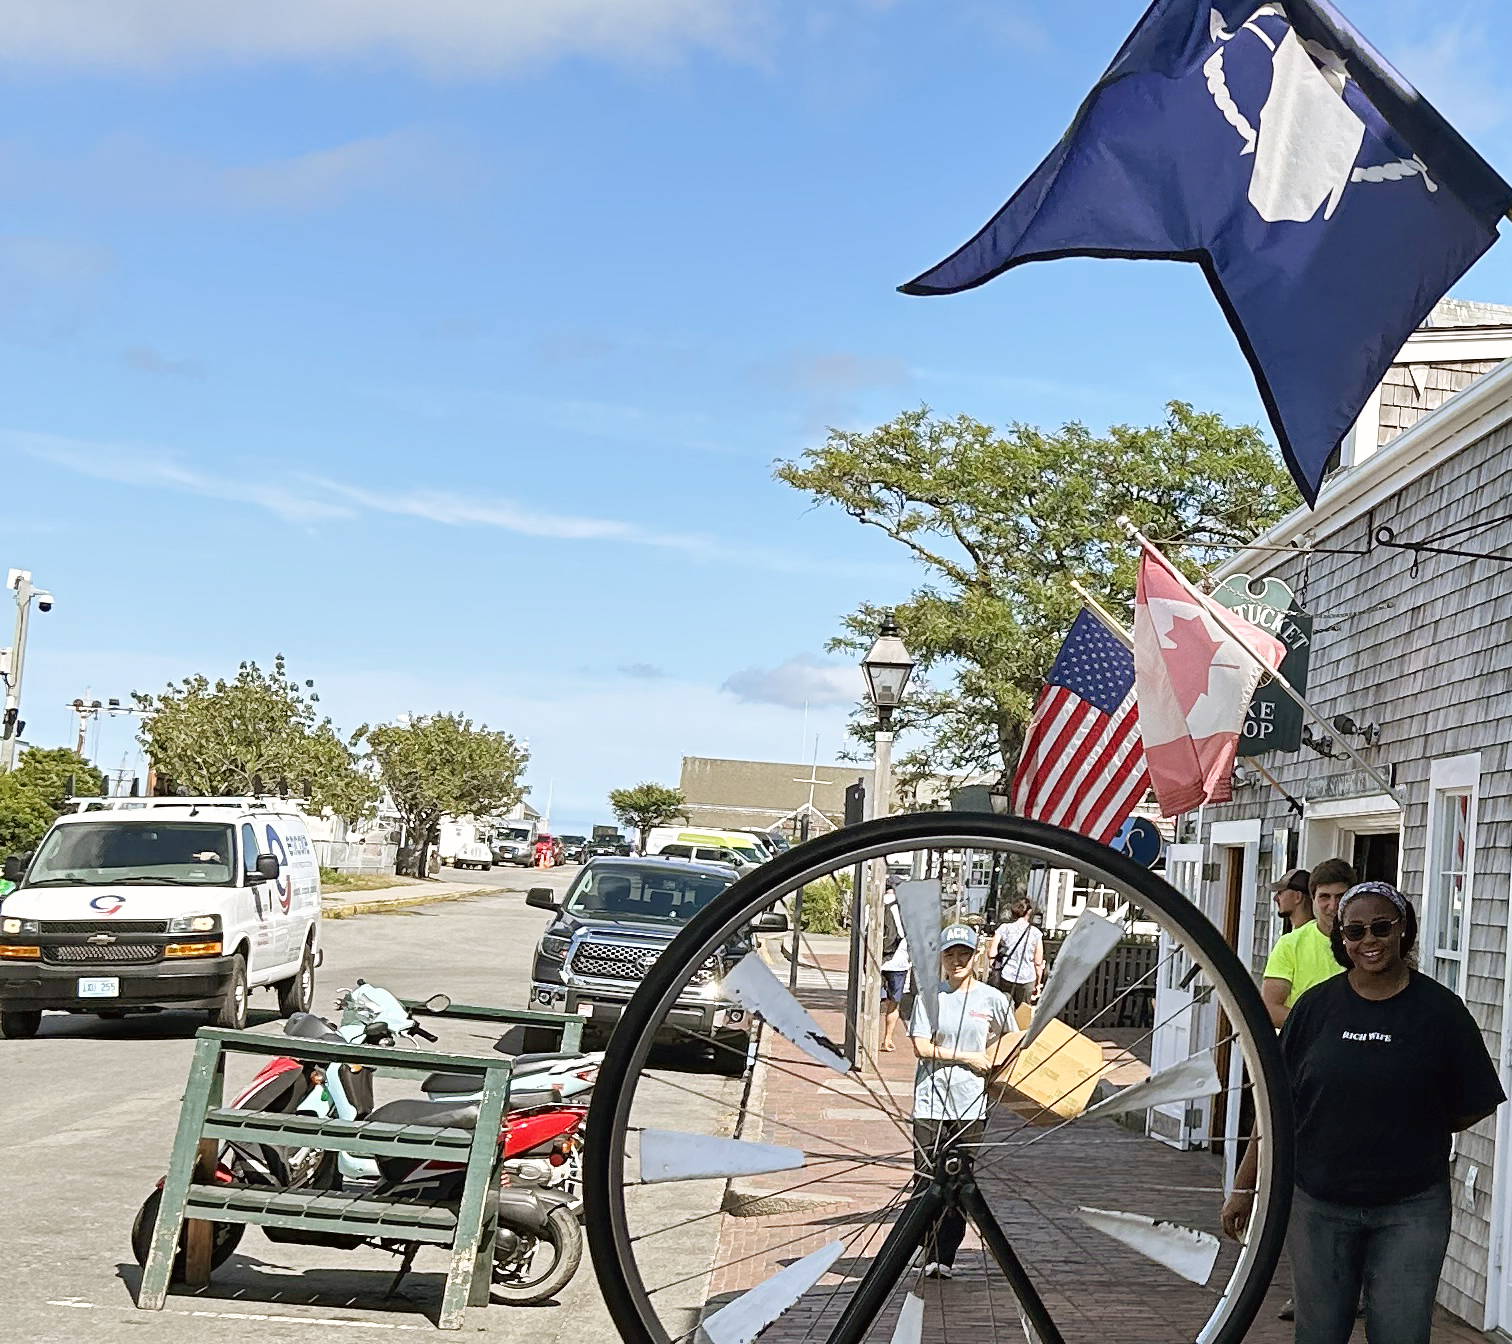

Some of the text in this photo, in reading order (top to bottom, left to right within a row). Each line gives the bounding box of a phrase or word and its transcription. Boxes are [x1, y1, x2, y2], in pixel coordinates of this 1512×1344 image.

[947, 928, 969, 940] ACK
[1342, 1030, 1392, 1043] RICH WIFE
